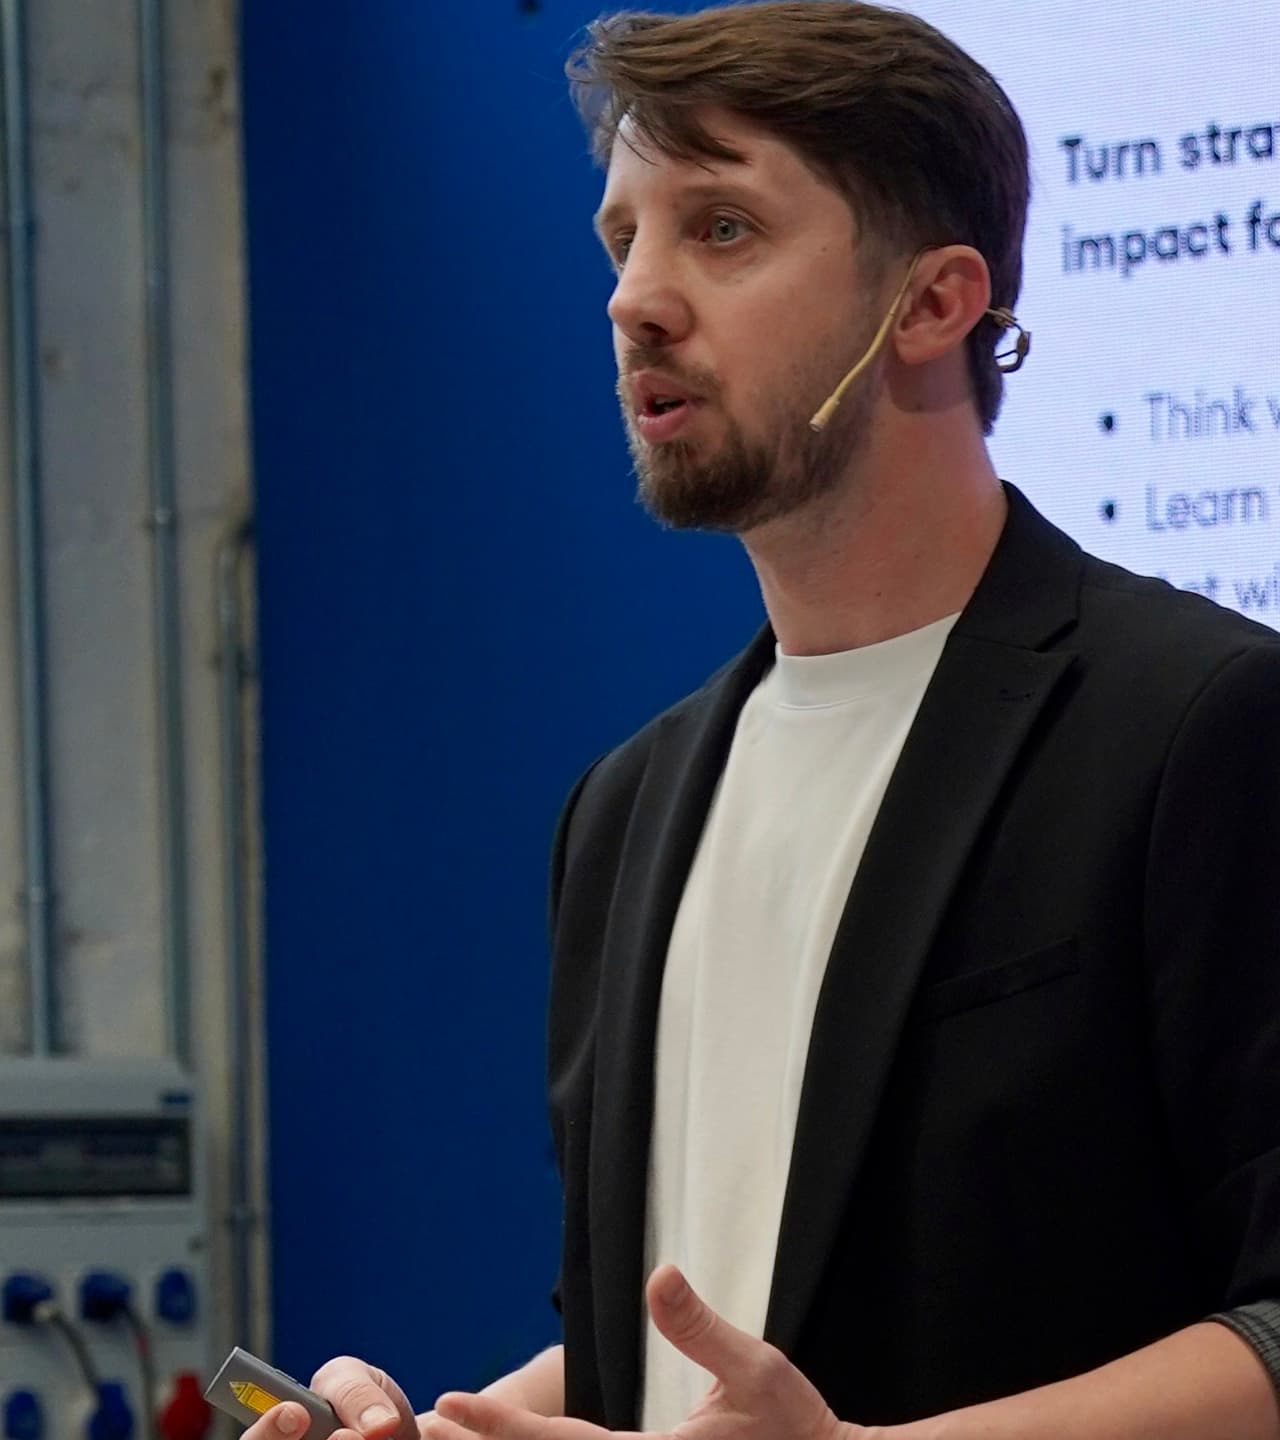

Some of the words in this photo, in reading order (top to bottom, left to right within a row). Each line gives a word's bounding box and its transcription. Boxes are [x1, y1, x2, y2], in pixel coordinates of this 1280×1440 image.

[1061, 135, 1163, 184] Turn
[1061, 204, 1232, 276] impact
[1147, 383, 1255, 440] Think
[1147, 481, 1268, 530] Learn
